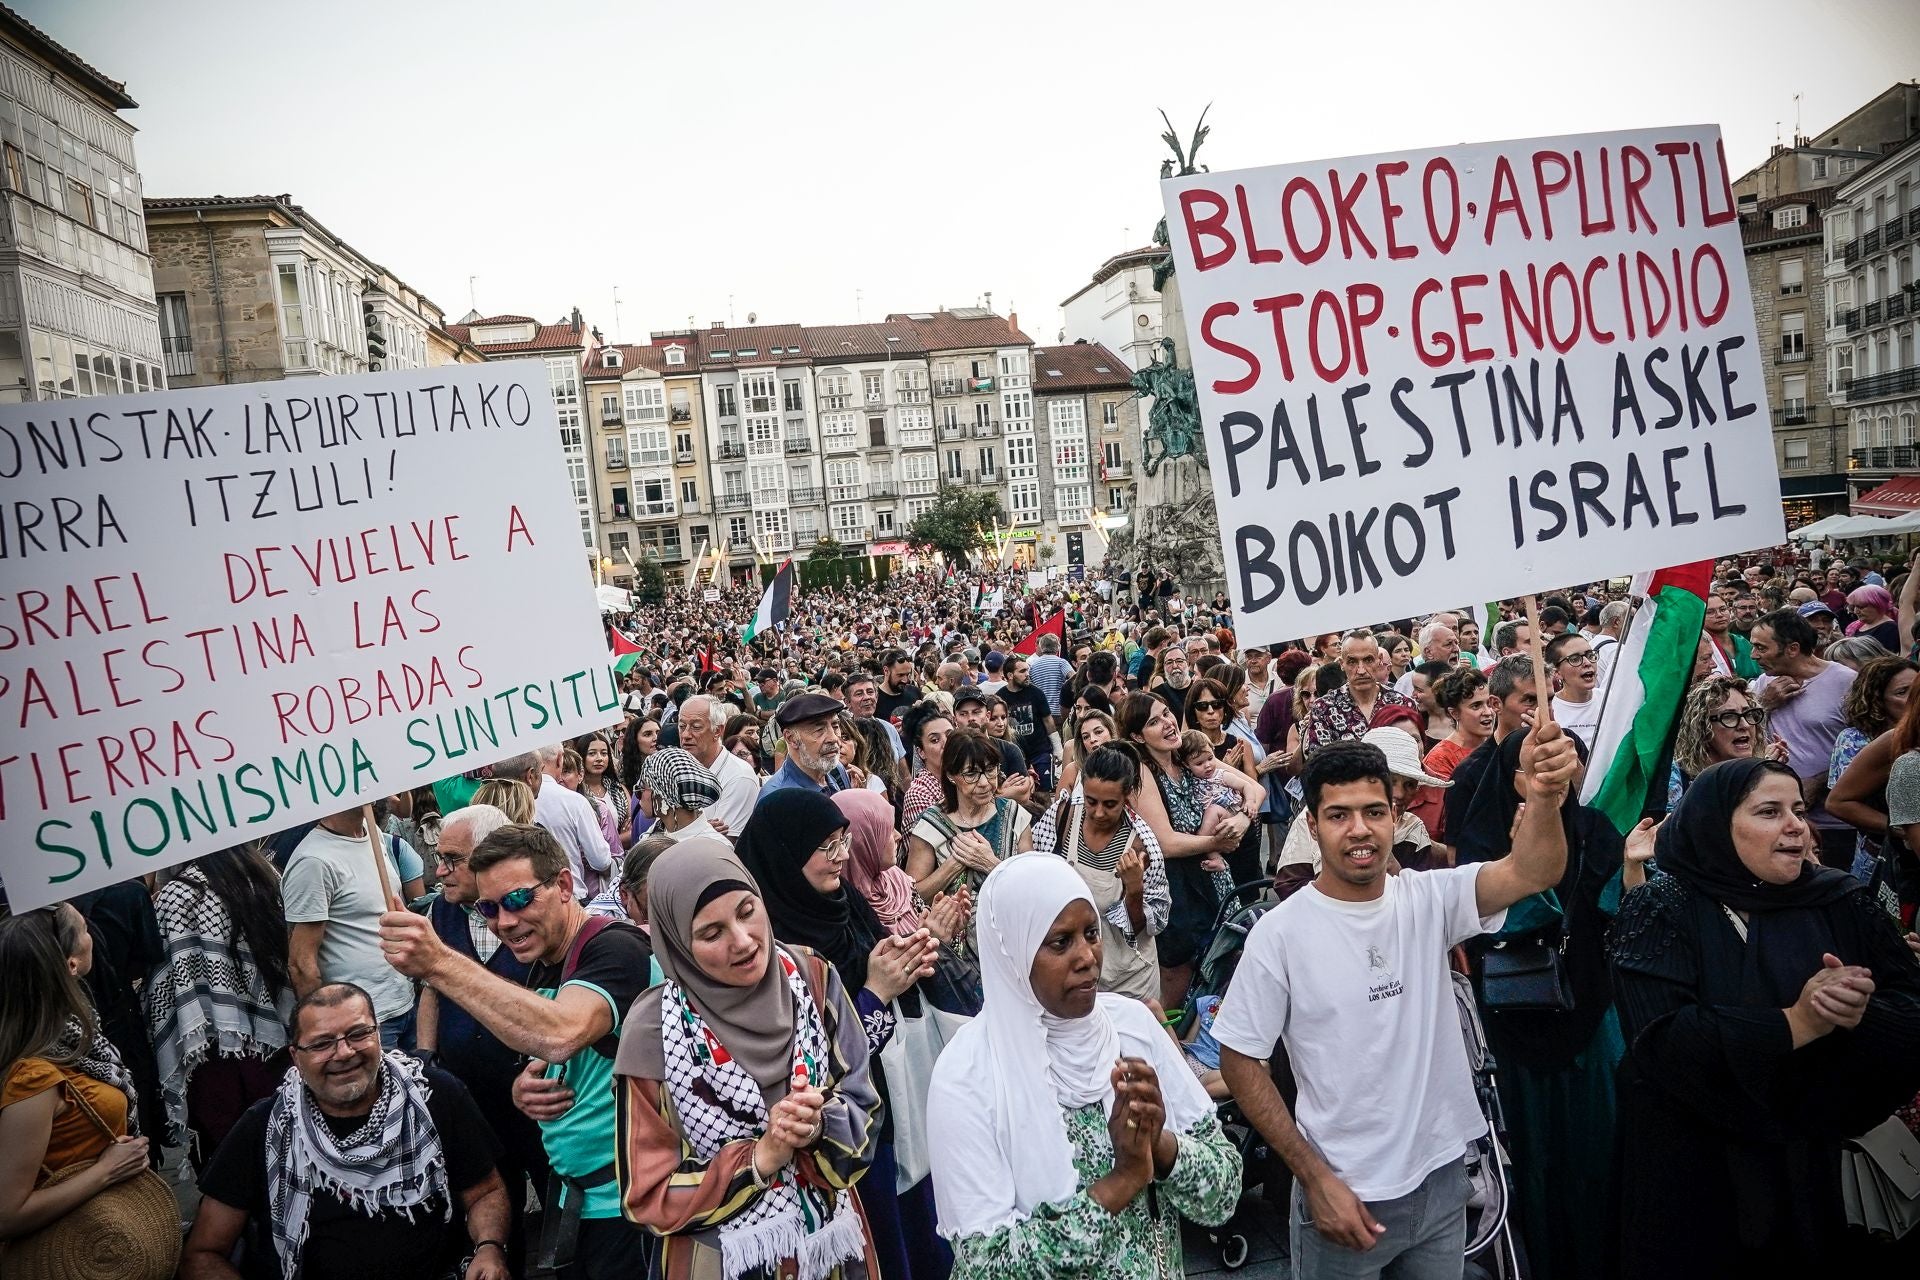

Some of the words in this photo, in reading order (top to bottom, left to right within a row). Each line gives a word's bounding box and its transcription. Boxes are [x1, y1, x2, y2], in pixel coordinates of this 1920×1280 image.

[1220, 357, 1586, 498] PALESTINA
[1612, 336, 1758, 440] ASKE
[0, 494, 128, 560] RRA
[185, 450, 397, 527] ITZULI!
[224, 516, 470, 604] DEVUELVE
[508, 506, 535, 553] A
[1236, 487, 1462, 614] BOIKOT
[1509, 442, 1747, 550] ISRAEL
[354, 590, 441, 649] LAS
[272, 646, 483, 744] ROBADAS
[35, 738, 379, 885] SIONISMOA
[407, 665, 621, 771] SUNTSITU
[1368, 993, 1380, 1002] LOS
